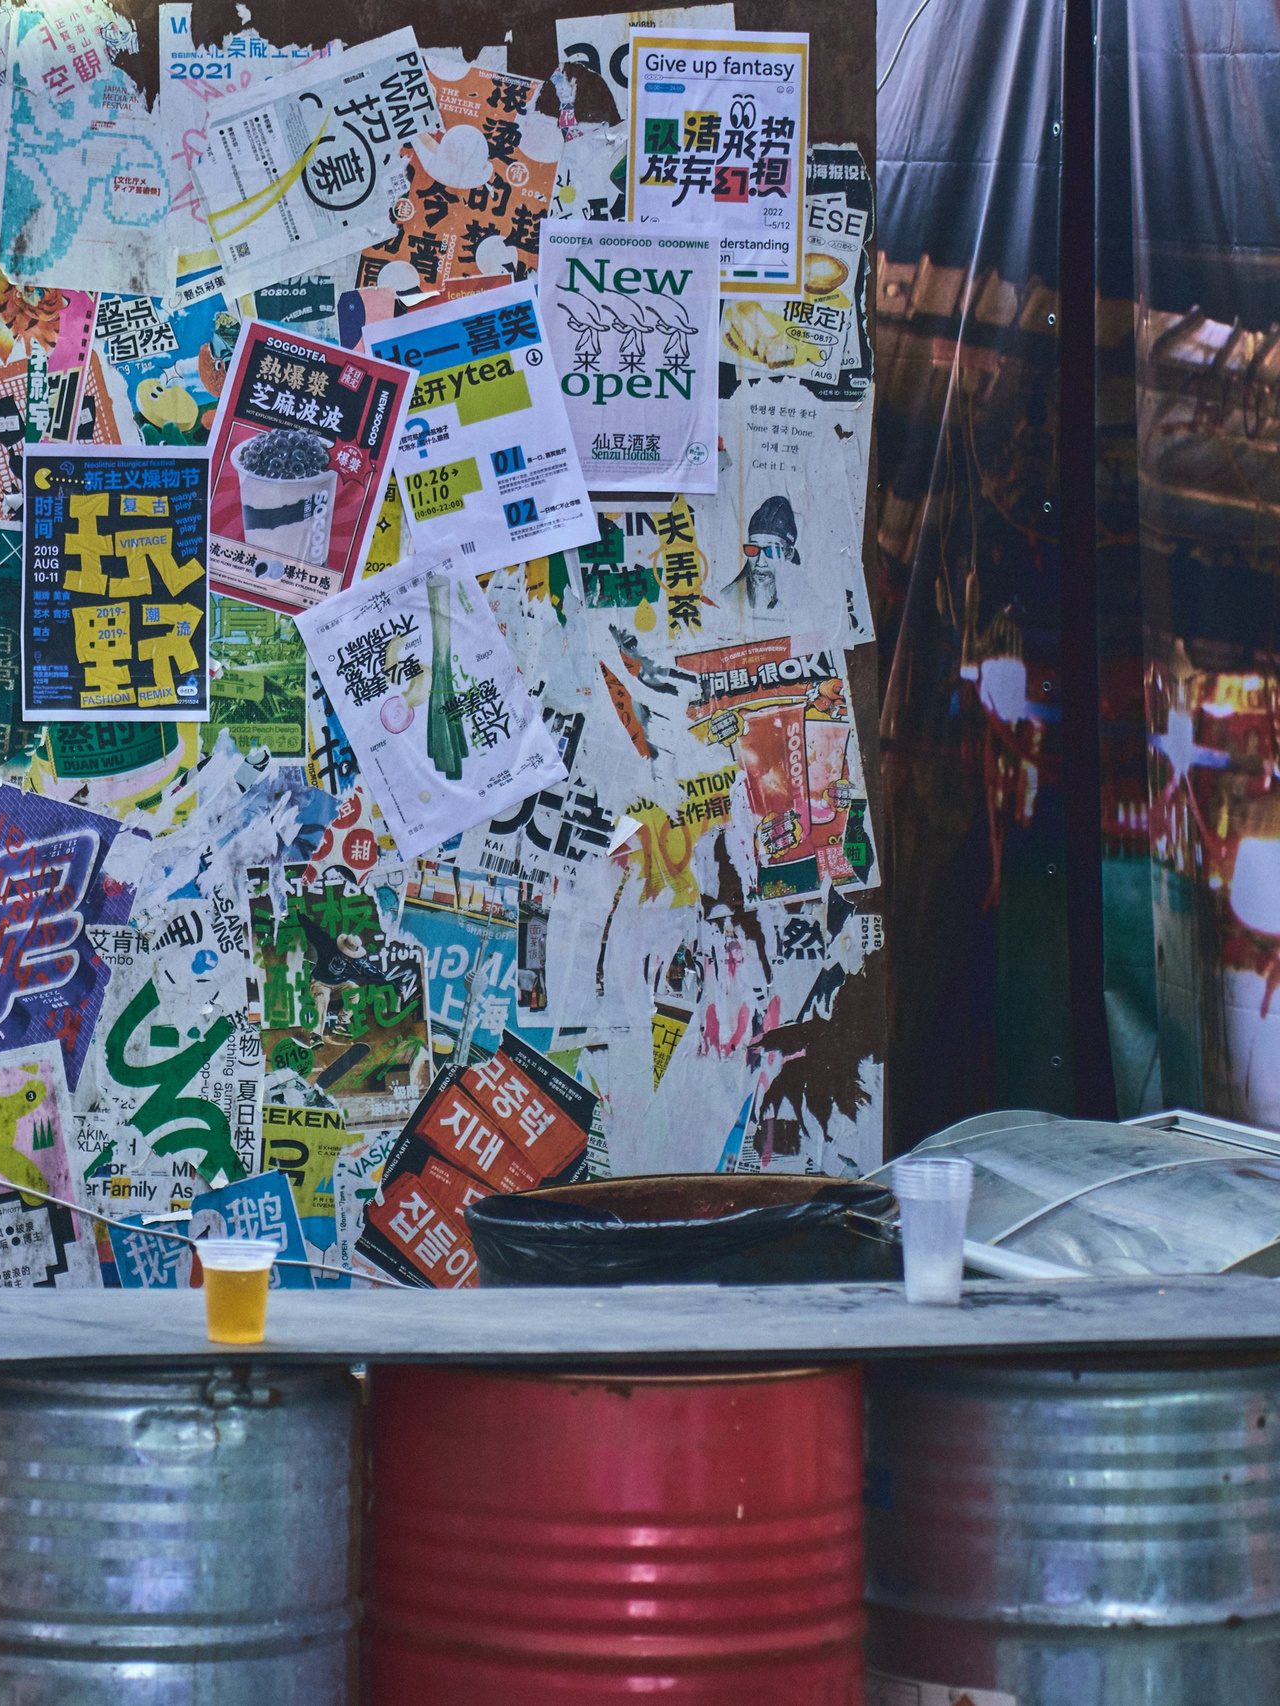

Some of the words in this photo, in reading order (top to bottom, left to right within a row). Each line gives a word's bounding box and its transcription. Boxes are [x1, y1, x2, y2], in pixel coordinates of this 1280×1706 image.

[170, 63, 232, 80] 2021
[645, 53, 687, 72] Give
[693, 59, 718, 78] up
[723, 57, 795, 82] fantasy
[102, 93, 128, 103] MEDIA
[442, 88, 460, 98] THE
[438, 103, 480, 118] FESTIVAL
[440, 95, 482, 110] LANTERN
[647, 115, 796, 165] 认清形势
[639, 155, 790, 208] 放弃幻想
[763, 207, 783, 217] 2022
[772, 220, 791, 231] 5/12
[440, 232, 450, 252] FOR
[549, 235, 594, 246] GOODTEA
[599, 237, 653, 248] GOODFOOD
[658, 239, 710, 250] GOODWINE
[436, 252, 446, 273] YOU
[564, 257, 694, 296] New
[260, 288, 307, 297] 2020.08
[266, 336, 327, 365] SOGODTEA
[573, 350, 601, 374] 来
[619, 352, 646, 374] 来
[663, 354, 690, 376] 来
[447, 355, 516, 399] ytea
[560, 368, 697, 406] opeN
[249, 382, 344, 433] 芝麻波波
[379, 390, 390, 414] NEW
[367, 412, 384, 447] SOGOD
[591, 433, 662, 452] 仙豆酒家
[494, 447, 521, 475] 01
[591, 448, 621, 461] Senzu
[621, 448, 661, 462] Hotdish
[84, 461, 117, 470] Neolithic
[149, 459, 176, 468] festival
[171, 491, 199, 504] wanye
[53, 496, 64, 524] TIME
[151, 499, 167, 515] 古
[174, 501, 193, 513] play
[507, 498, 538, 527] 02
[175, 513, 203, 526] wanye
[179, 523, 197, 535] play
[34, 546, 60, 556] 2019
[120, 535, 168, 550] VINTAGE
[176, 535, 204, 549] wanye
[180, 546, 199, 558] play
[33, 558, 60, 570] AUG
[34, 572, 59, 583] 10-11
[145, 606, 161, 624] 潮
[81, 692, 131, 706] FASHION
[139, 688, 174, 701] REMIX
[787, 722, 804, 788] SOGOD
[473, 1057, 557, 1148] 무중력
[439, 1100, 506, 1173] 지대
[103, 1180, 157, 1201] Family
[342, 1239, 350, 1261] OPEN
